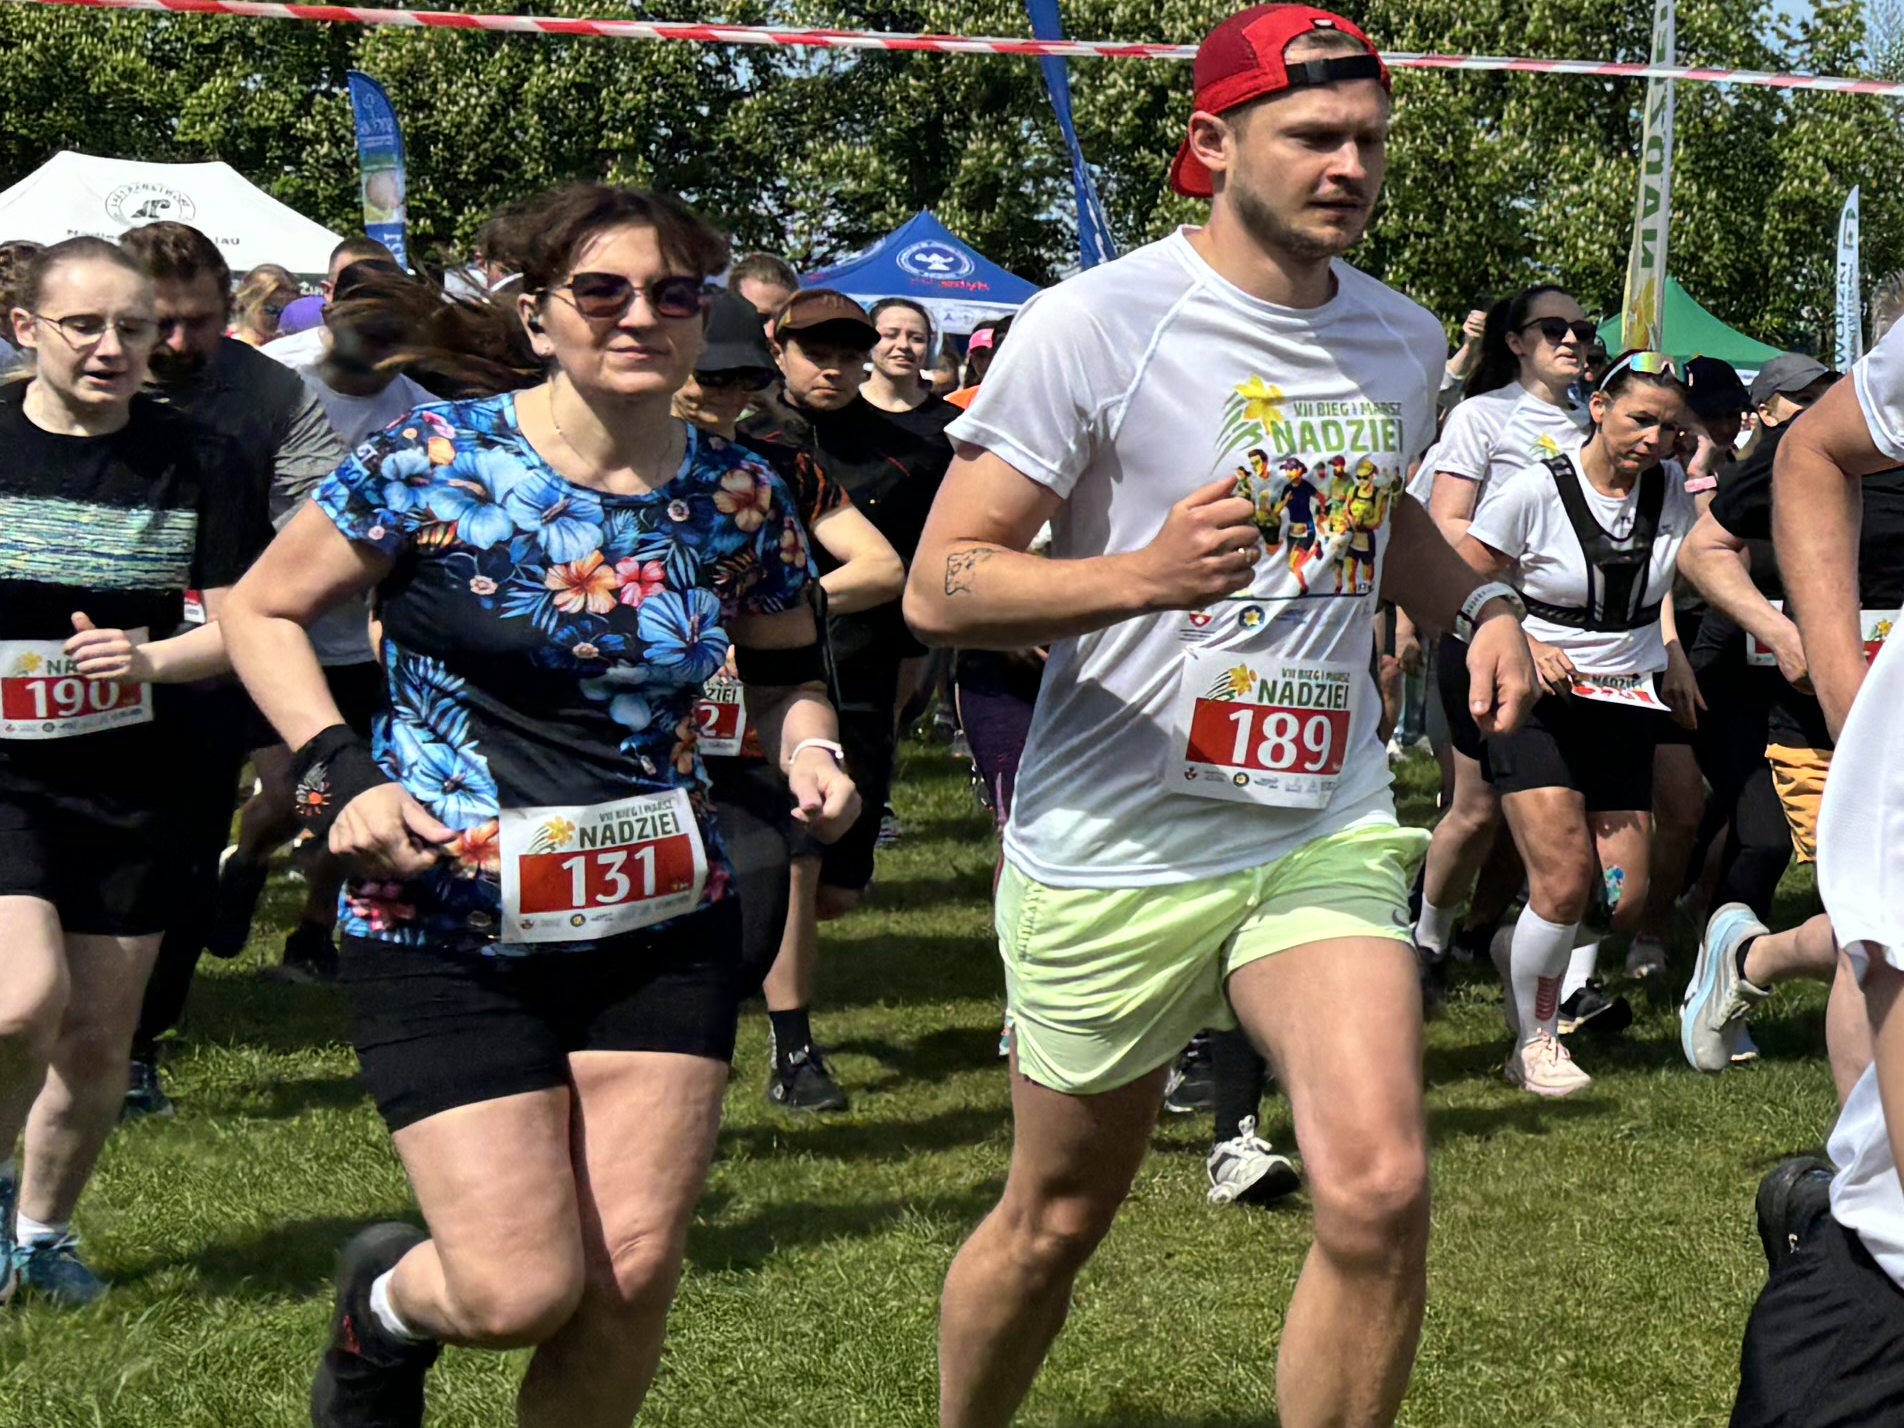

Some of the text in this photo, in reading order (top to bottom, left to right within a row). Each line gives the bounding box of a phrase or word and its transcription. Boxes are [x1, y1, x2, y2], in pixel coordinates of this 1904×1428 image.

[1316, 401, 1349, 416] BIEG
[1270, 419, 1404, 453] NADZIEI
[25, 678, 119, 718] 190
[1257, 678, 1349, 709] NADZIEI
[1229, 709, 1332, 772] 189
[579, 811, 680, 849] NADZIEI
[561, 845, 656, 907] 131
